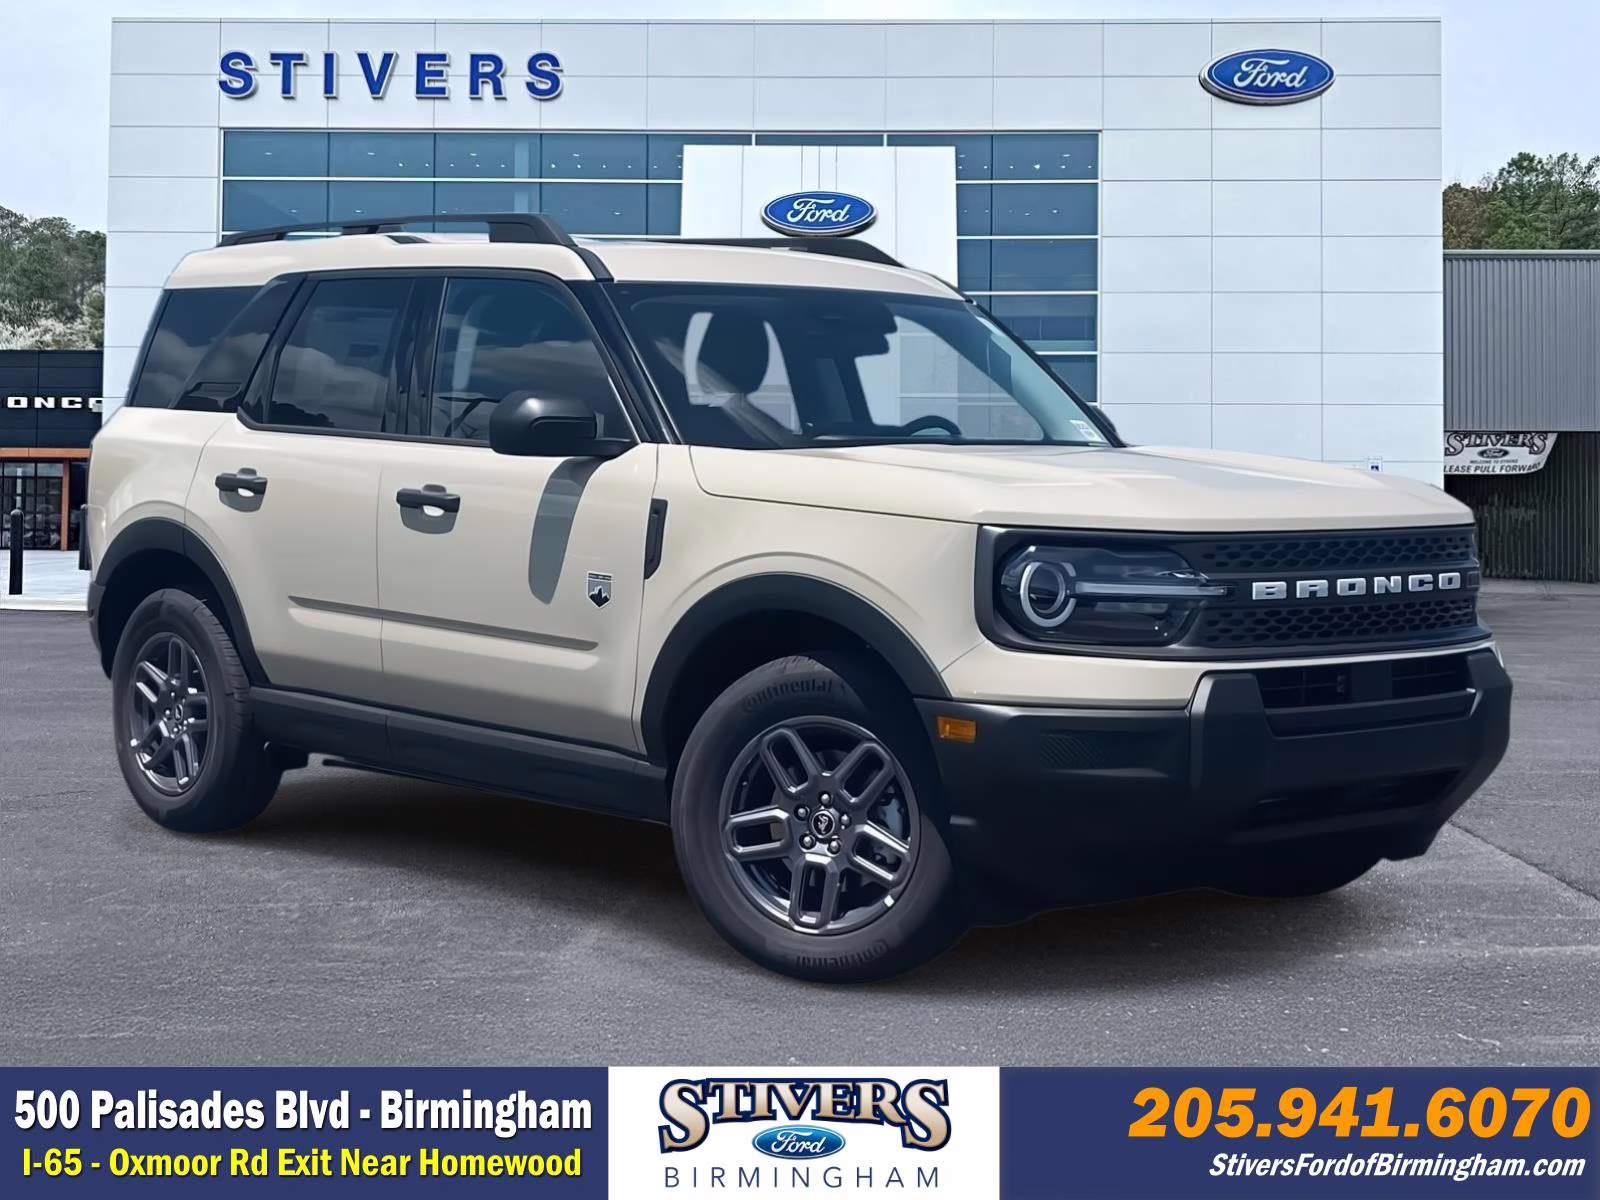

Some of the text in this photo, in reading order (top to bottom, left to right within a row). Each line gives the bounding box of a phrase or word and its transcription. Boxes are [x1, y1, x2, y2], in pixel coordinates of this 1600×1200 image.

[219, 51, 563, 101] STIVERS
[1232, 57, 1307, 90] Ford
[786, 197, 851, 225] Ford
[1444, 432, 1548, 457] STIVERS
[1474, 464, 1496, 473] PULL
[1252, 572, 1462, 600] BRONCO
[742, 678, 833, 713] Continental
